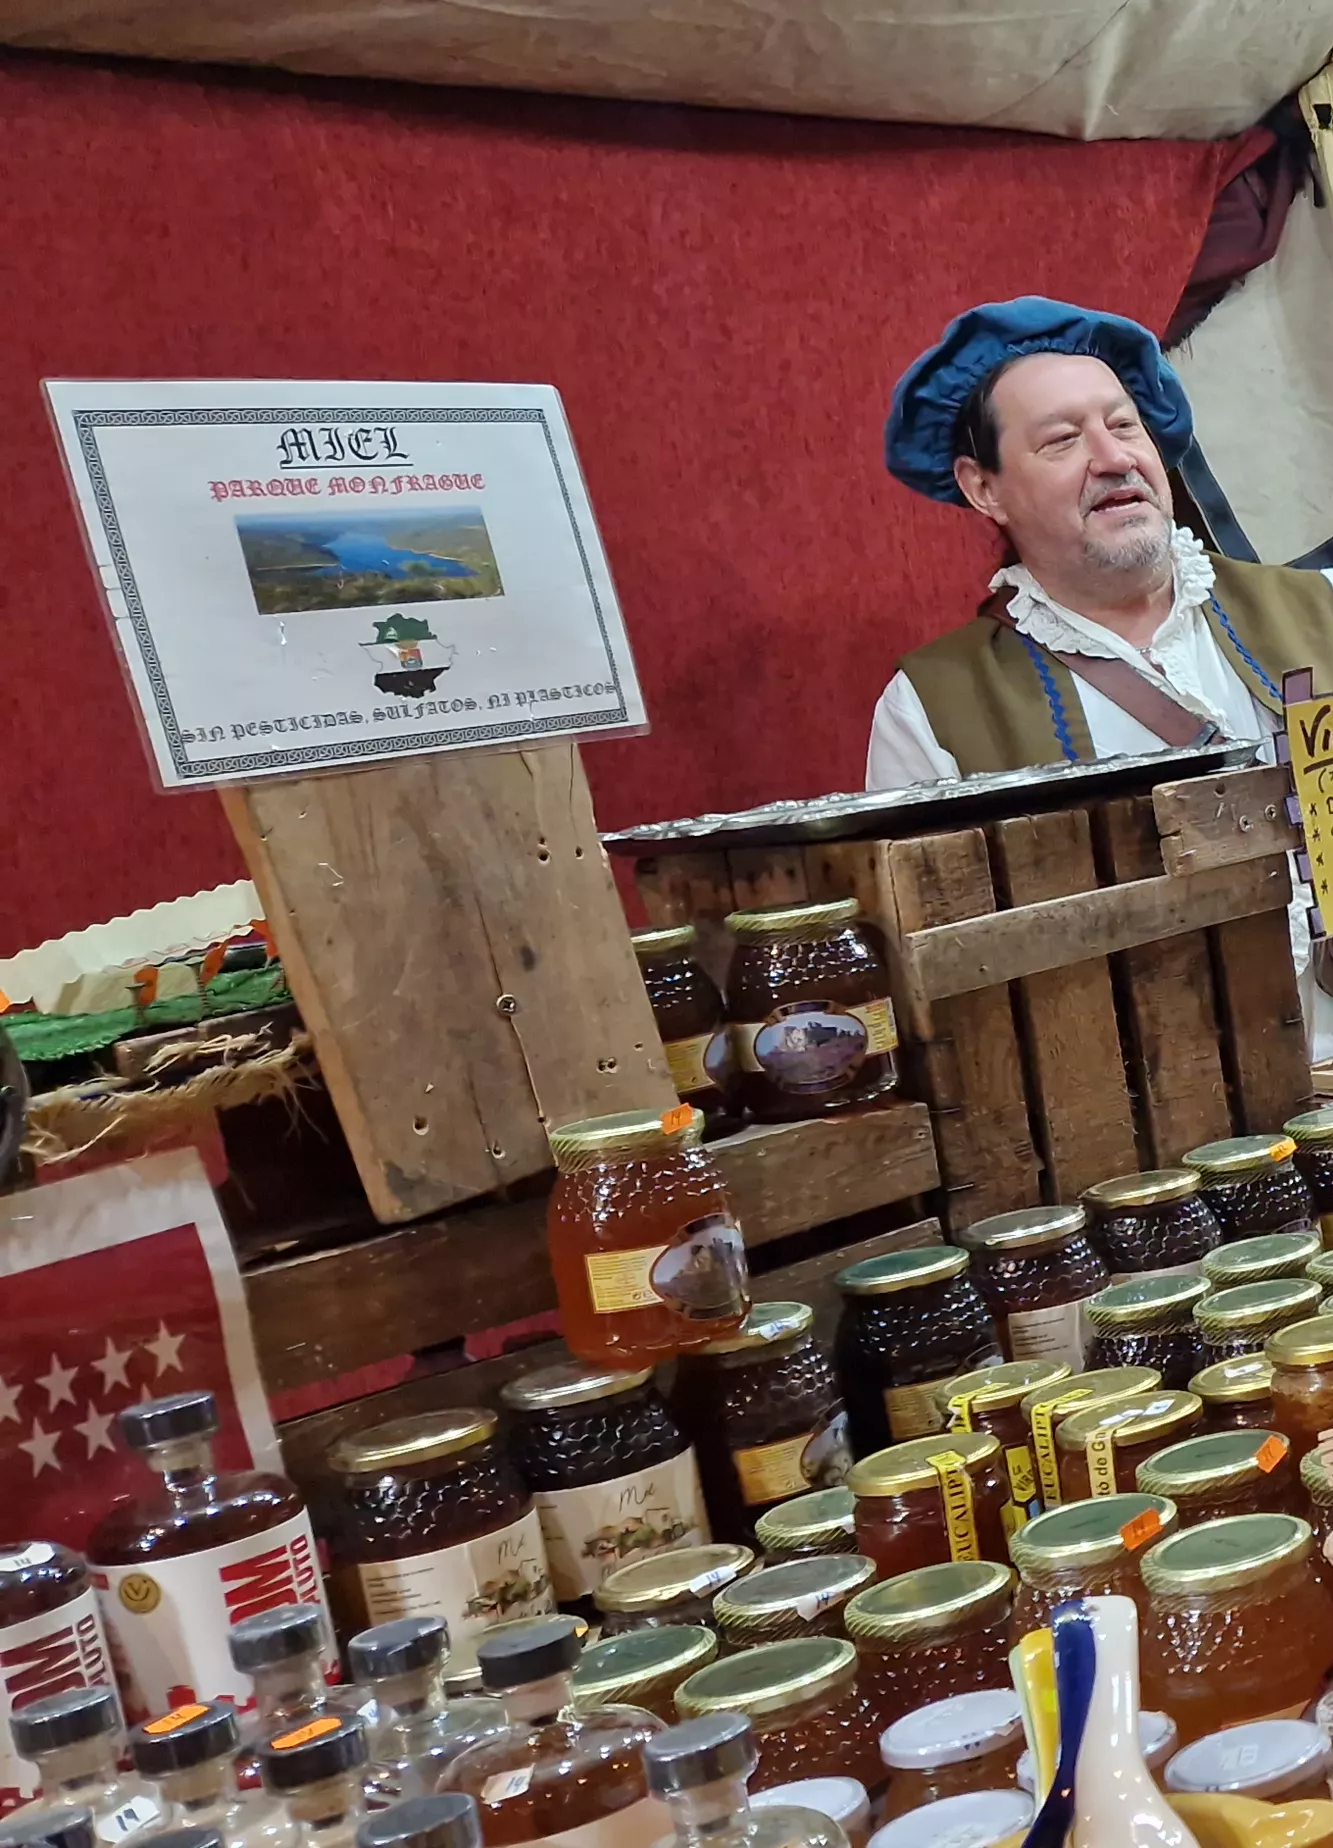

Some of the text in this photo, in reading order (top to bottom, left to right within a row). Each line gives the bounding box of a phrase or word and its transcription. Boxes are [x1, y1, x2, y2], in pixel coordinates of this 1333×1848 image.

[276, 426, 410, 465] MIEL
[208, 473, 486, 502] PARQUE MONFRAGUE
[181, 725, 226, 744] SIN
[486, 693, 511, 709] NI
[514, 682, 617, 708] PLASTICOS
[945, 1464, 974, 1562] EUCALIPT
